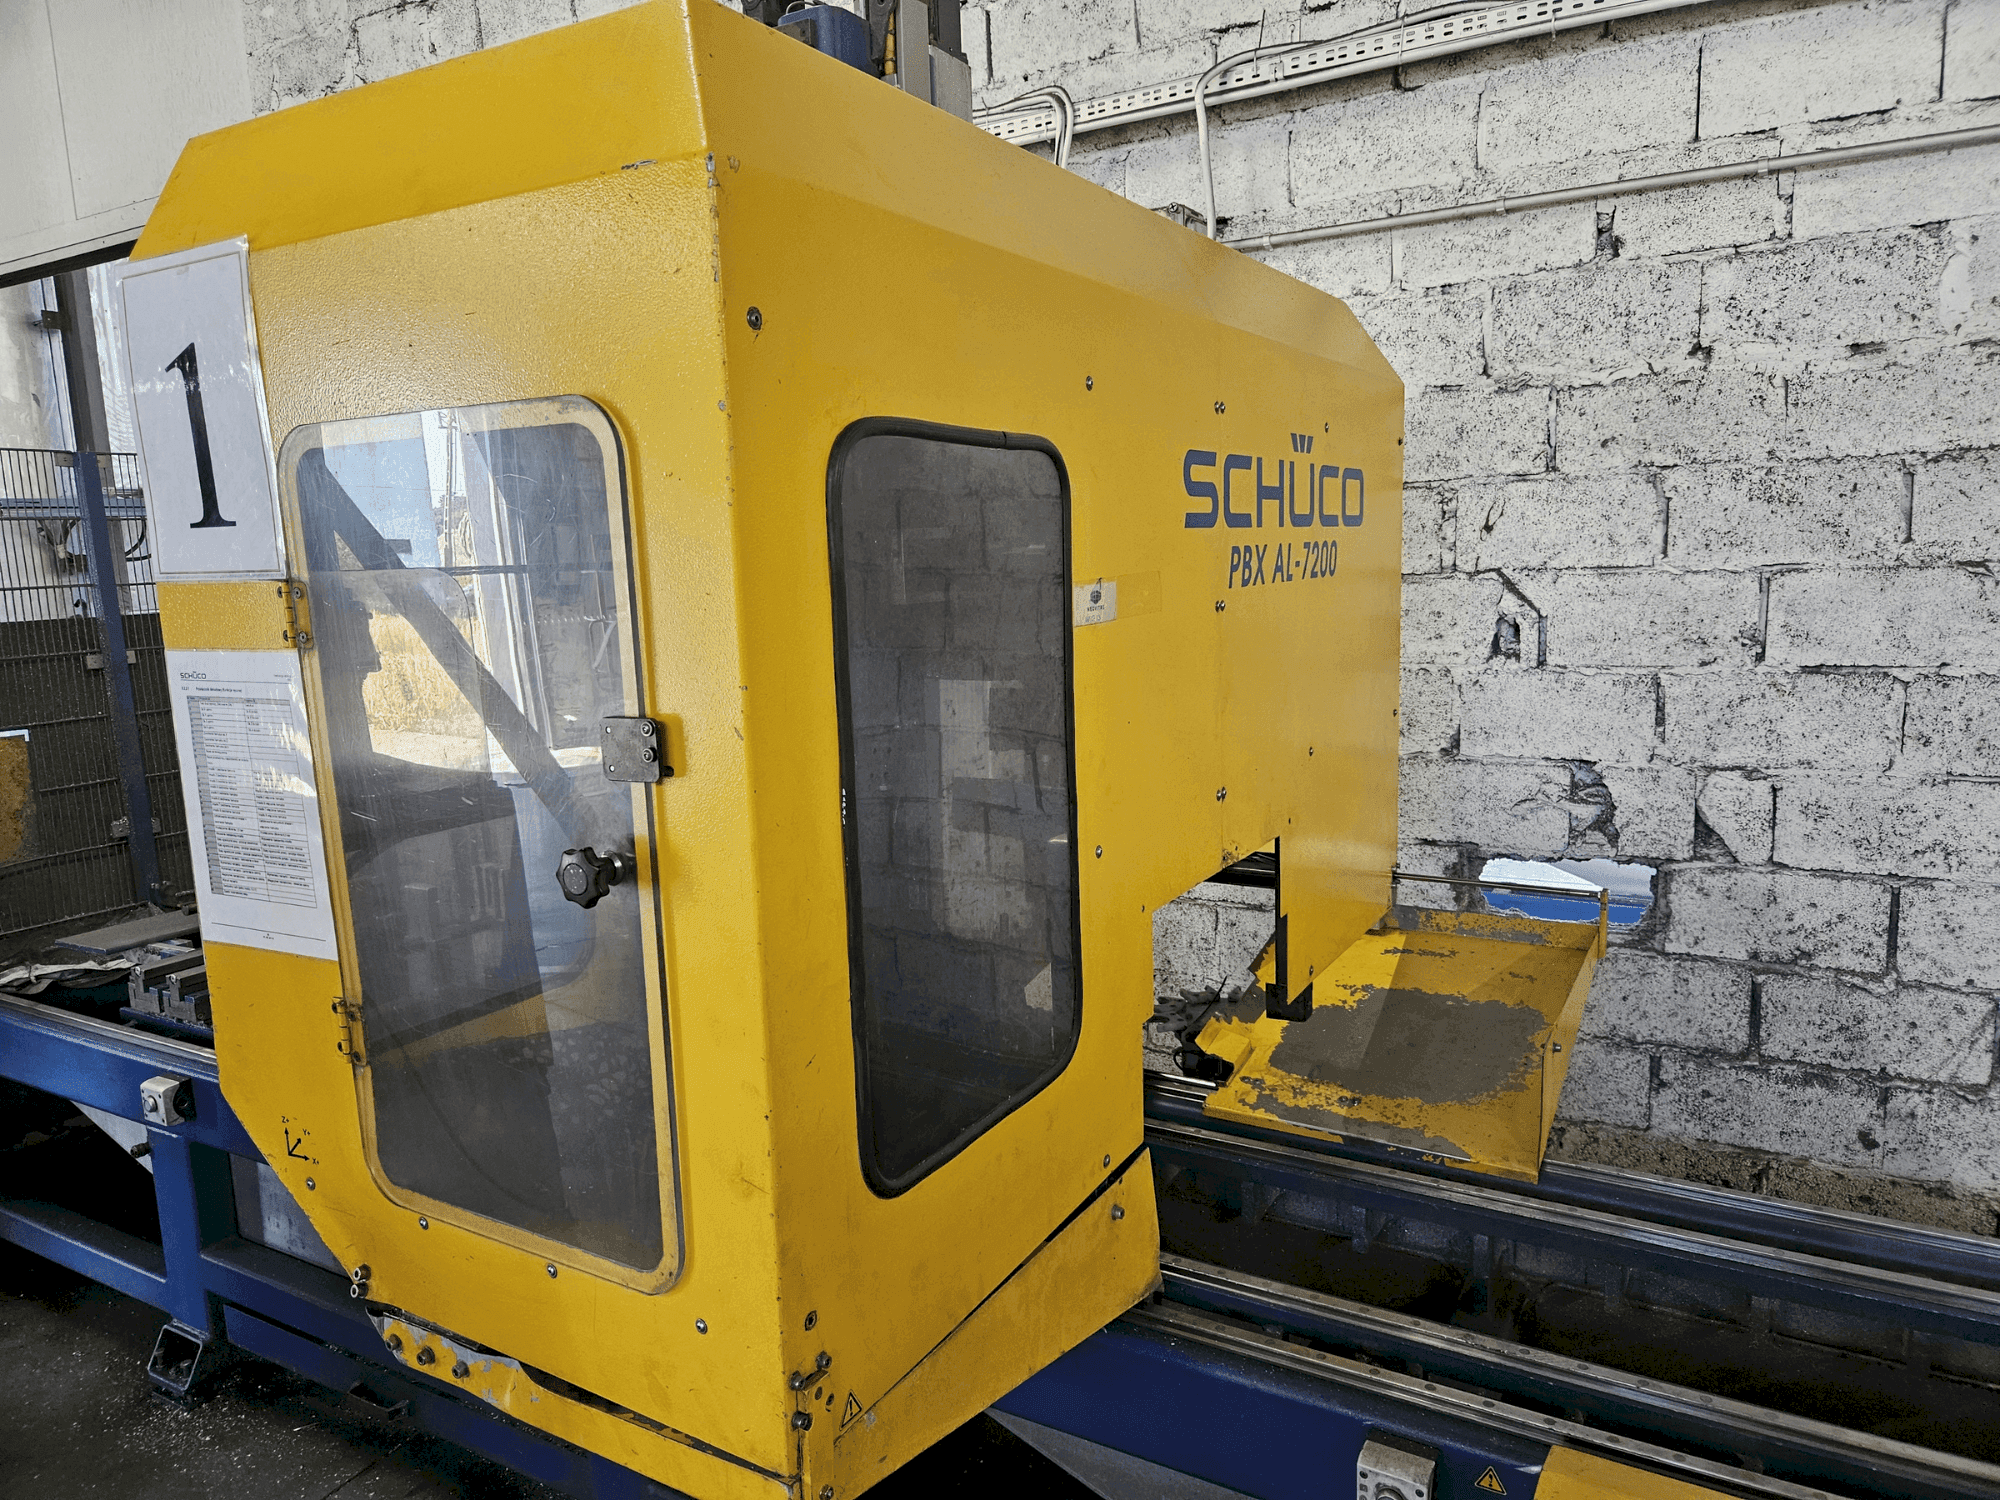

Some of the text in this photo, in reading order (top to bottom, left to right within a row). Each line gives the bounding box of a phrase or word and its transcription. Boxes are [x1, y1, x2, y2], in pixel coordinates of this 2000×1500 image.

[165, 342, 237, 529] 1
[1183, 432, 1364, 529] SCHÜCO
[1228, 539, 1338, 589] PBX AL-7200
